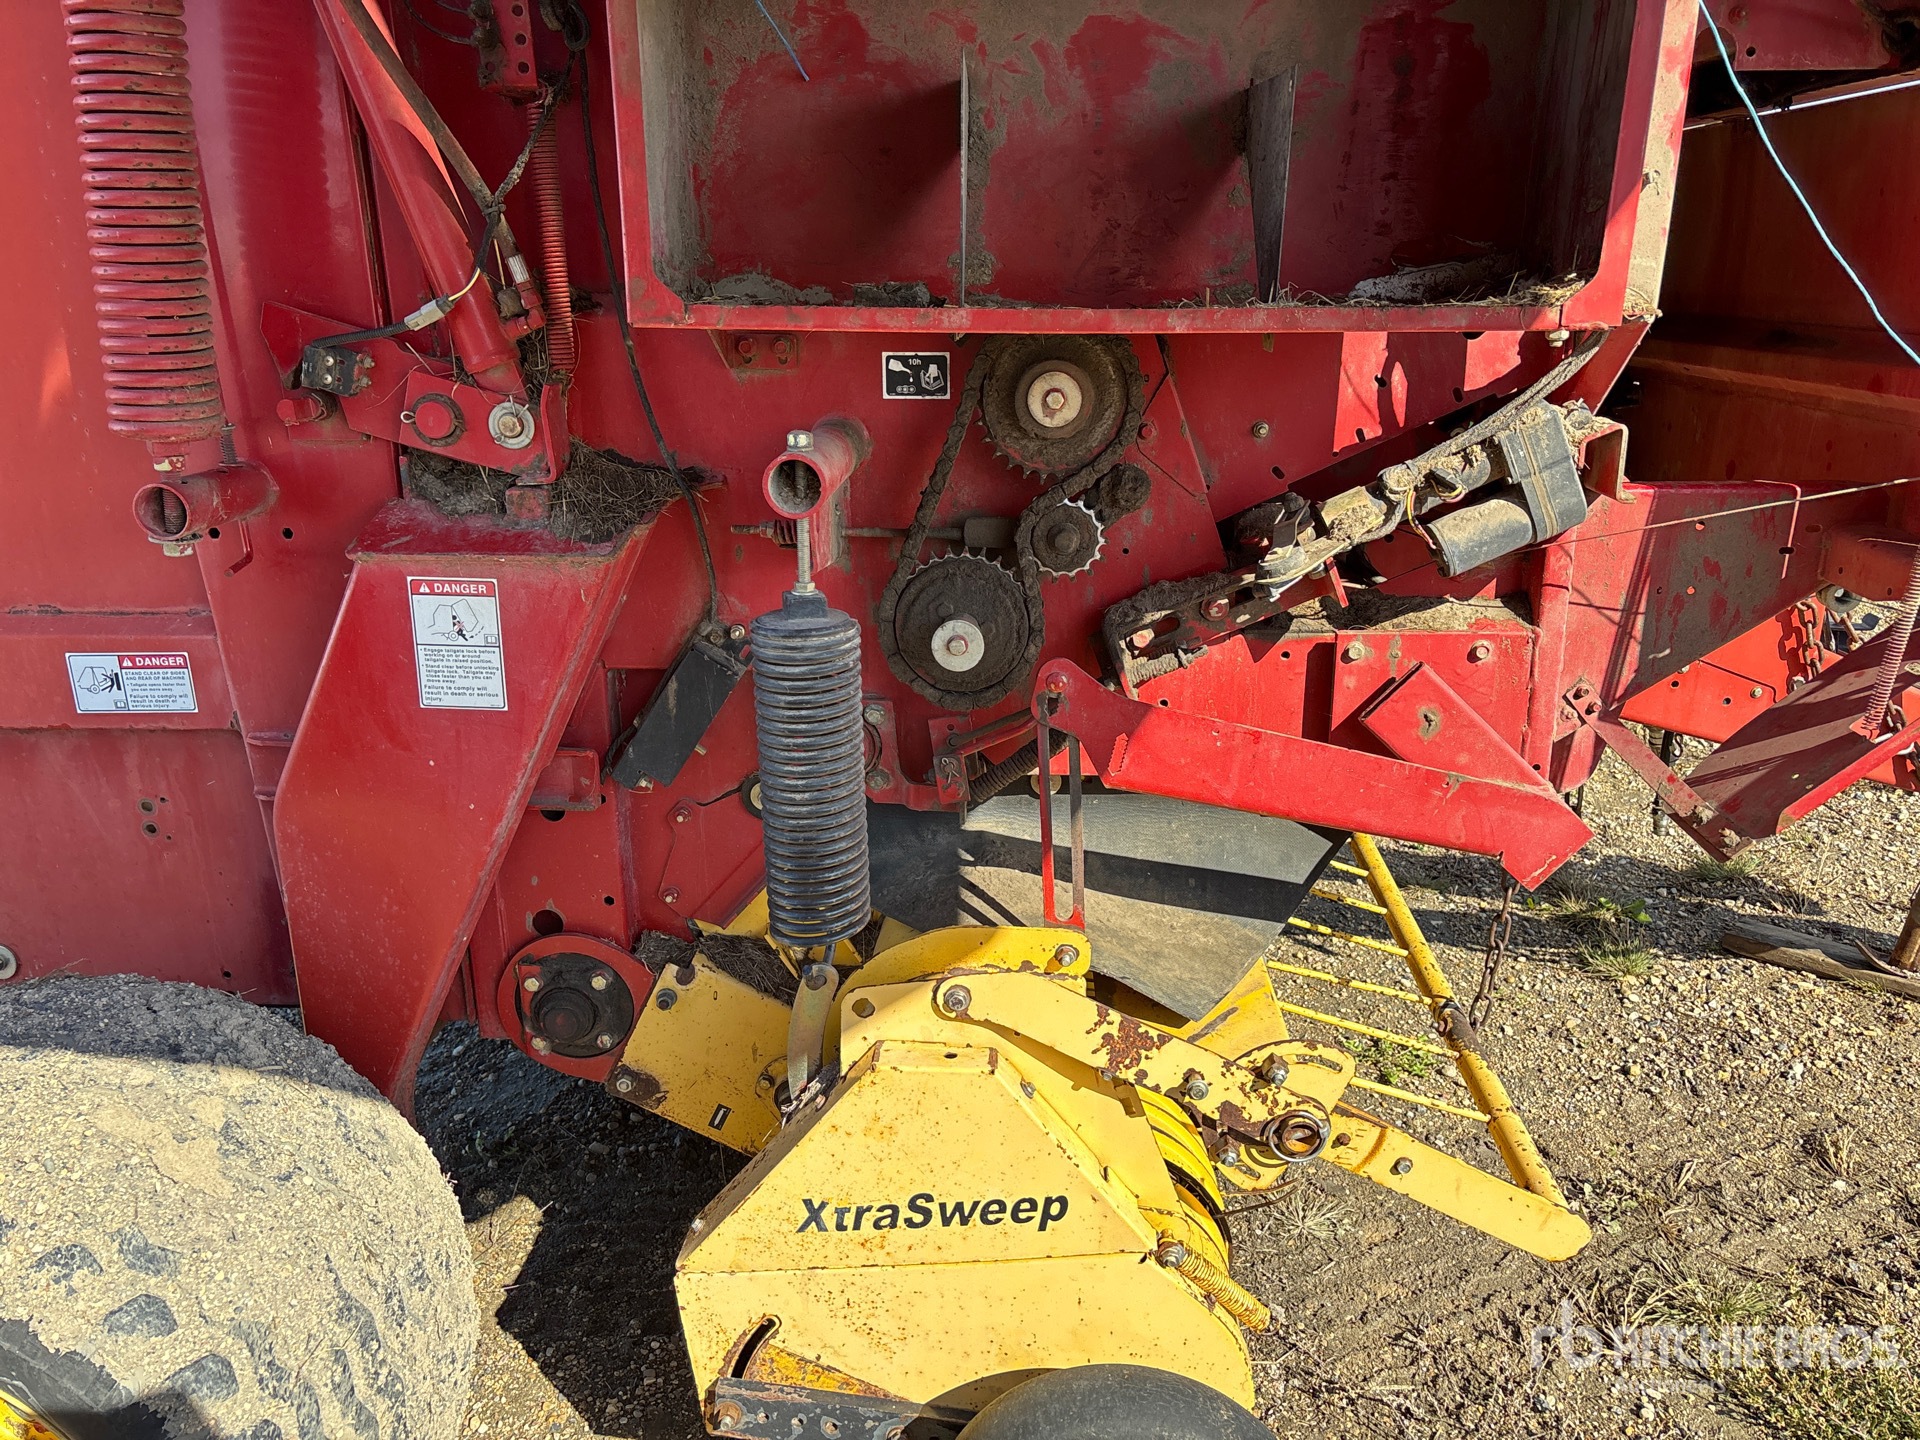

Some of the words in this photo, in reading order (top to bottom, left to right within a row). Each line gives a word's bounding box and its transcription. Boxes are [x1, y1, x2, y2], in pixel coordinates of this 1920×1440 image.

[434, 584, 486, 594] DANGER
[136, 657, 184, 665] DANGER
[796, 1192, 1069, 1234] XtraSweep
